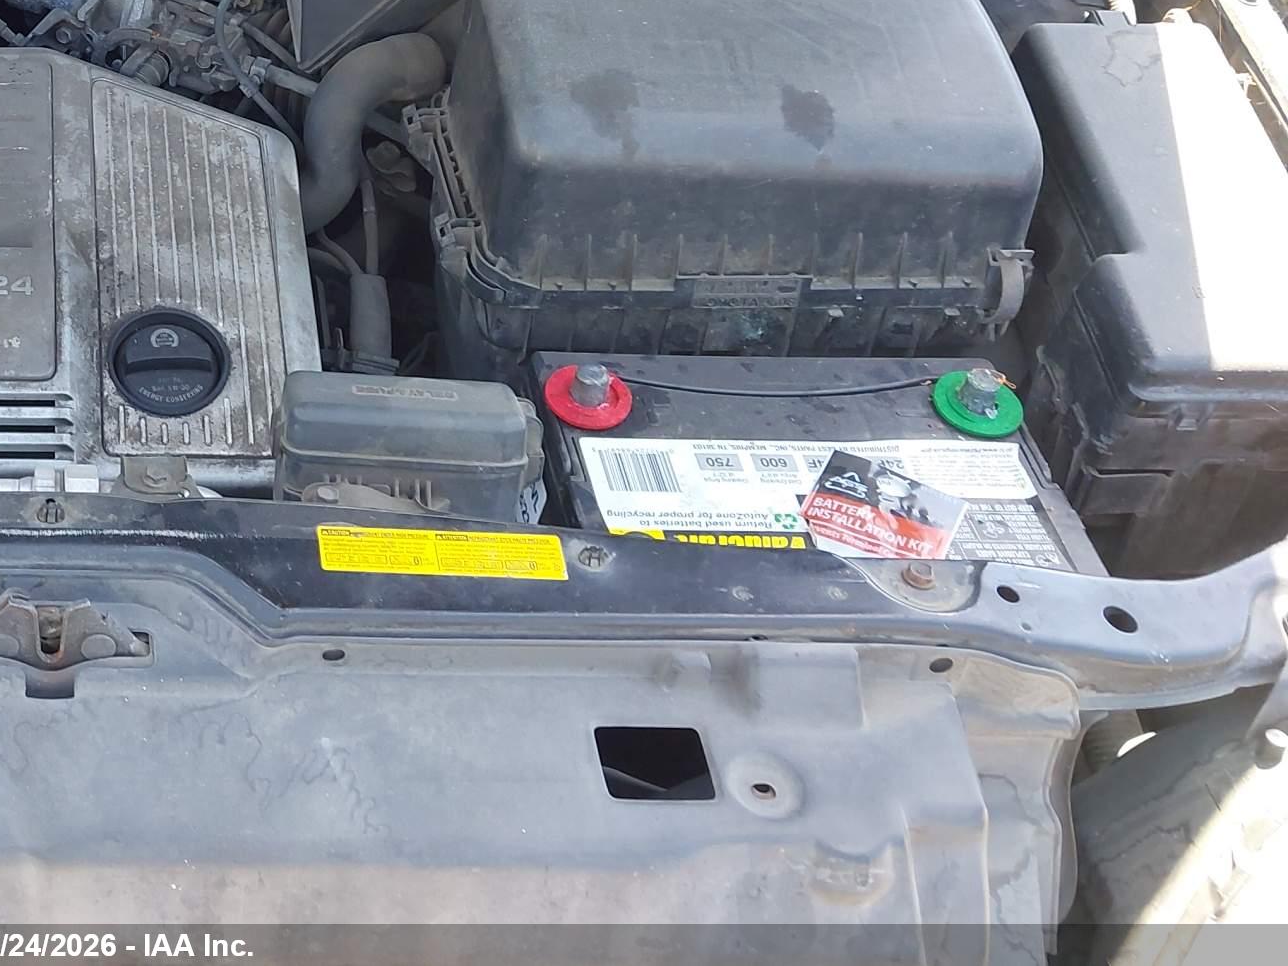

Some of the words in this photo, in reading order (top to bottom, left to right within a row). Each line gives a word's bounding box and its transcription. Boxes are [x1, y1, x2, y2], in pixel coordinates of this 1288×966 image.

[705, 457, 733, 467] 750
[759, 457, 788, 468] 600
[606, 509, 656, 519] recycling
[813, 496, 877, 523] BATTERY
[658, 510, 695, 519] proper
[696, 511, 712, 519] for
[716, 512, 769, 520] AutoZone
[639, 519, 651, 527] to
[653, 519, 702, 528] batteries
[705, 520, 732, 529] used
[735, 520, 773, 530] Return
[807, 508, 908, 546] INSTALLATION
[907, 536, 932, 554] KIT
